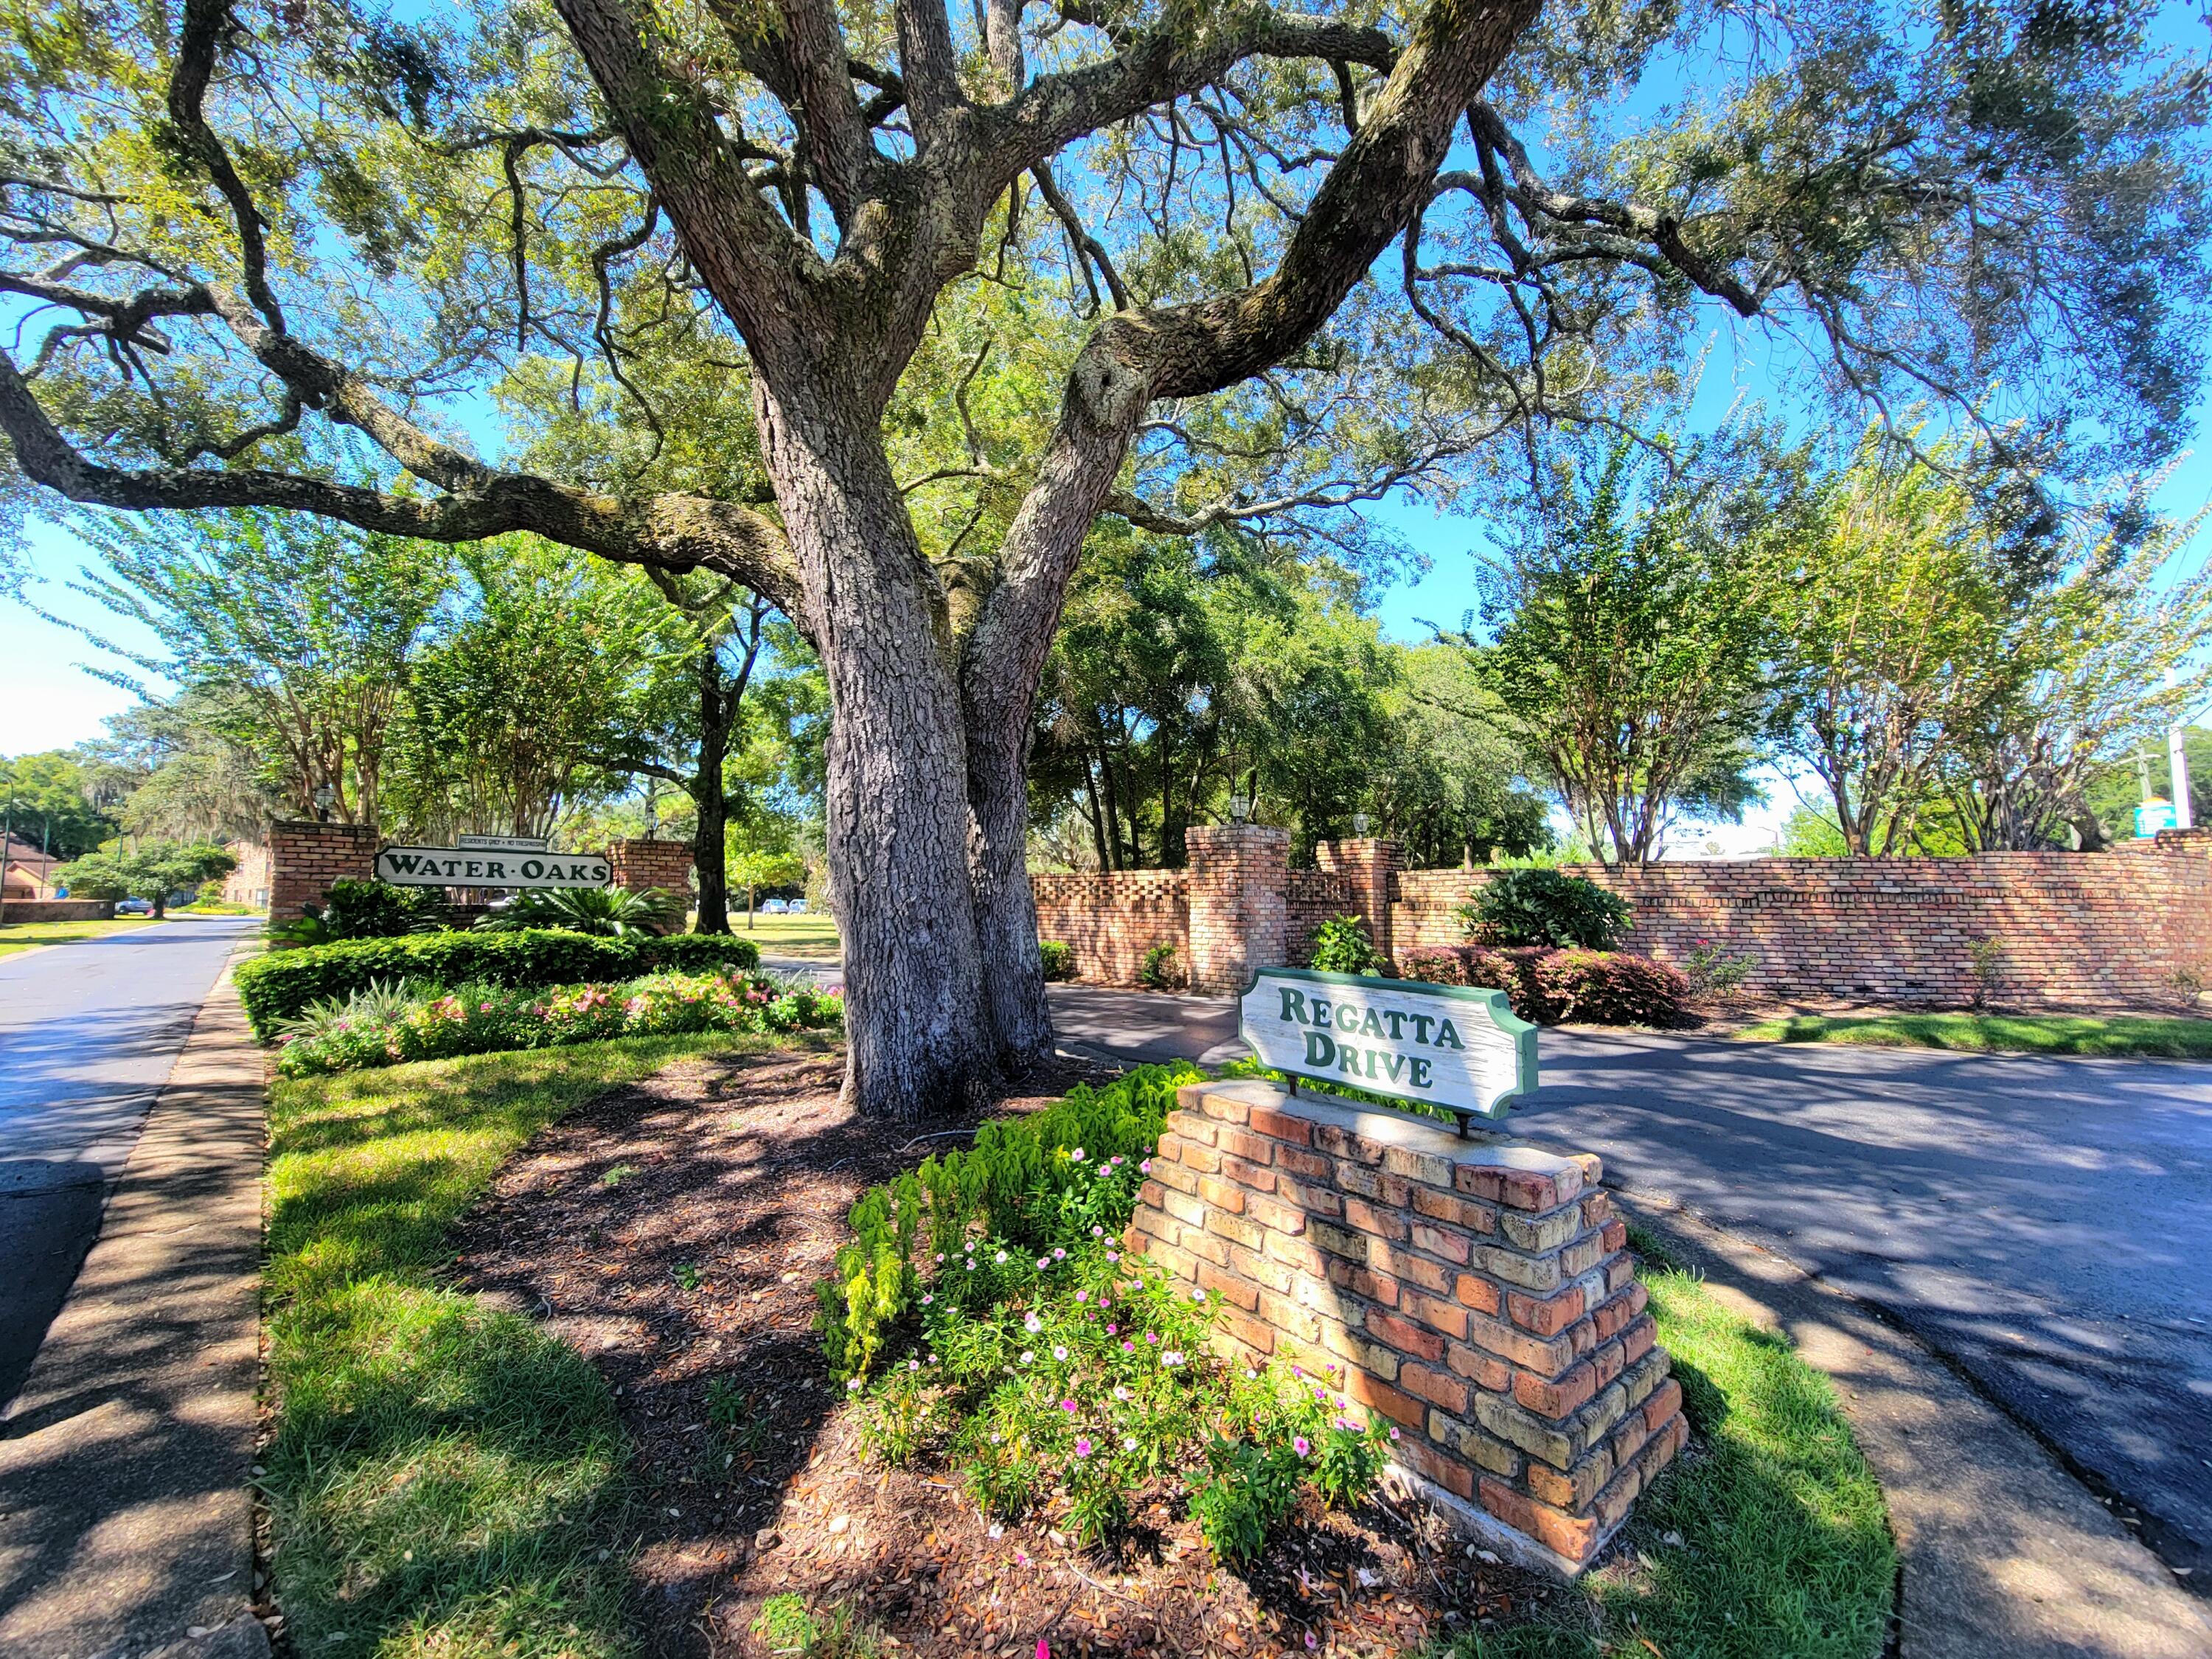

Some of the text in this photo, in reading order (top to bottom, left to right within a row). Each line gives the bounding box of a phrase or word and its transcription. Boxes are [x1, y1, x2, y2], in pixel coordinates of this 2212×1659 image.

[385, 854, 607, 881] WATER OAKS
[1278, 987, 1466, 1050] REGATTA
[1303, 1031, 1433, 1089] DRIVE
